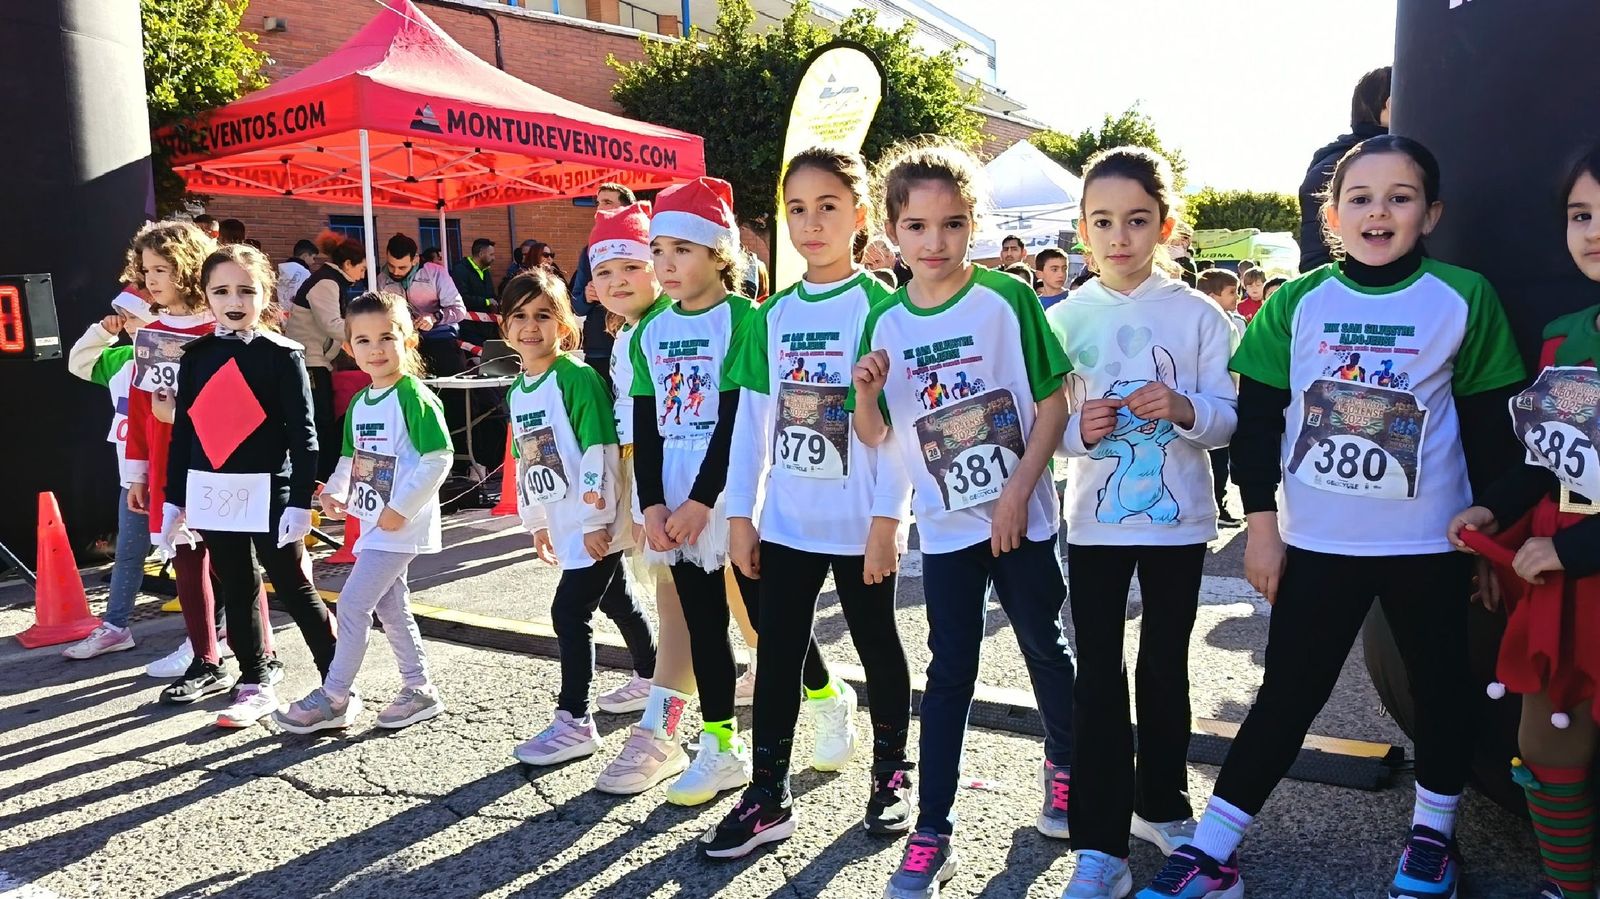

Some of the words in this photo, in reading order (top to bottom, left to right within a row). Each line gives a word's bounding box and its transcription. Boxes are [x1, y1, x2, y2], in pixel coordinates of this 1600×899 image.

[447, 108, 677, 170] MONTUREVENTOS.COM
[1341, 323, 1363, 334] SAN
[1364, 324, 1416, 336] SILVESTRE
[915, 344, 932, 357] SAN
[932, 335, 974, 353] SILVESTRE
[151, 365, 179, 387] 39
[1549, 388, 1598, 404] ALBOJENSE
[1556, 398, 1581, 412] 2025
[1310, 413, 1320, 423] 28
[1333, 402, 1384, 418] ALBOJENSE
[1343, 414, 1369, 426] 2025
[780, 430, 826, 464] 379
[1531, 424, 1592, 479] 385
[948, 446, 1009, 494] 381
[1314, 438, 1387, 482] 380
[528, 468, 555, 494] 400
[200, 486, 250, 518] 389
[353, 486, 377, 511] 86
